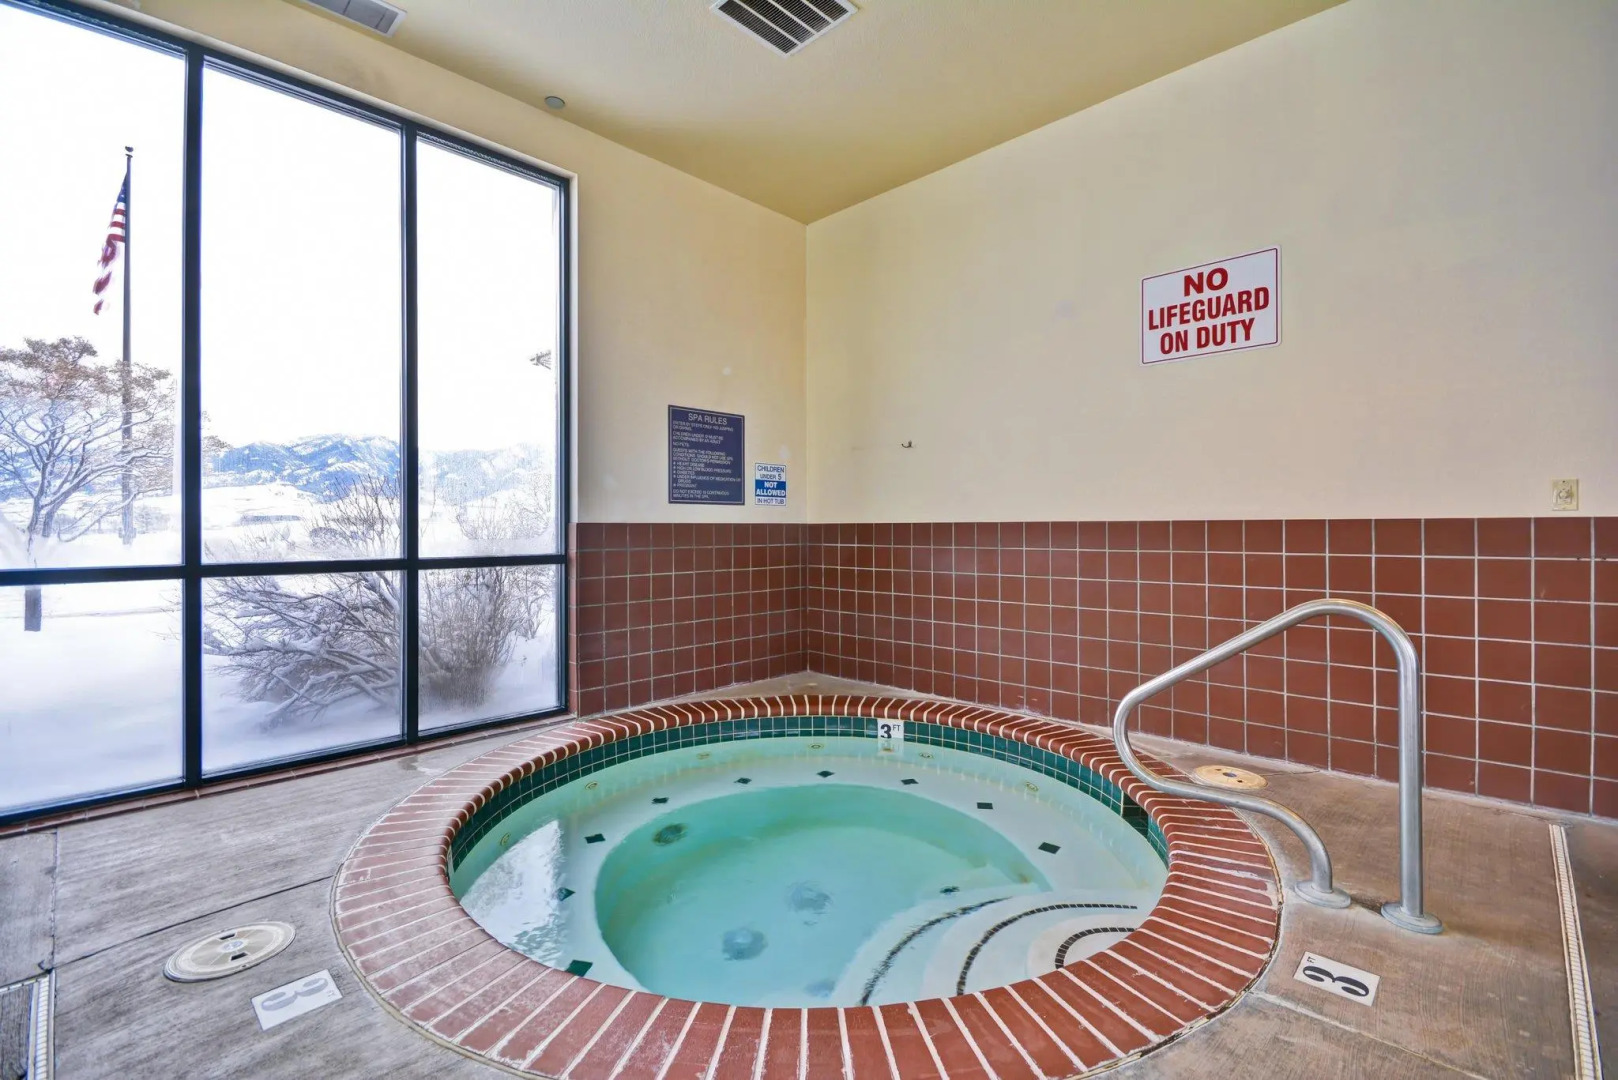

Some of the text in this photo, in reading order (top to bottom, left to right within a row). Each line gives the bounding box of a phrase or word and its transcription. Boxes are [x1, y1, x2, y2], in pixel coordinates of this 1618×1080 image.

[1184, 268, 1228, 297] NO
[1149, 287, 1269, 330] LIFEGUARD
[1161, 318, 1255, 354] ON DUTY
[688, 413, 727, 425] SPA RULES
[881, 724, 892, 739] 3
[261, 977, 329, 1011] 3
[1302, 966, 1369, 997] 3
